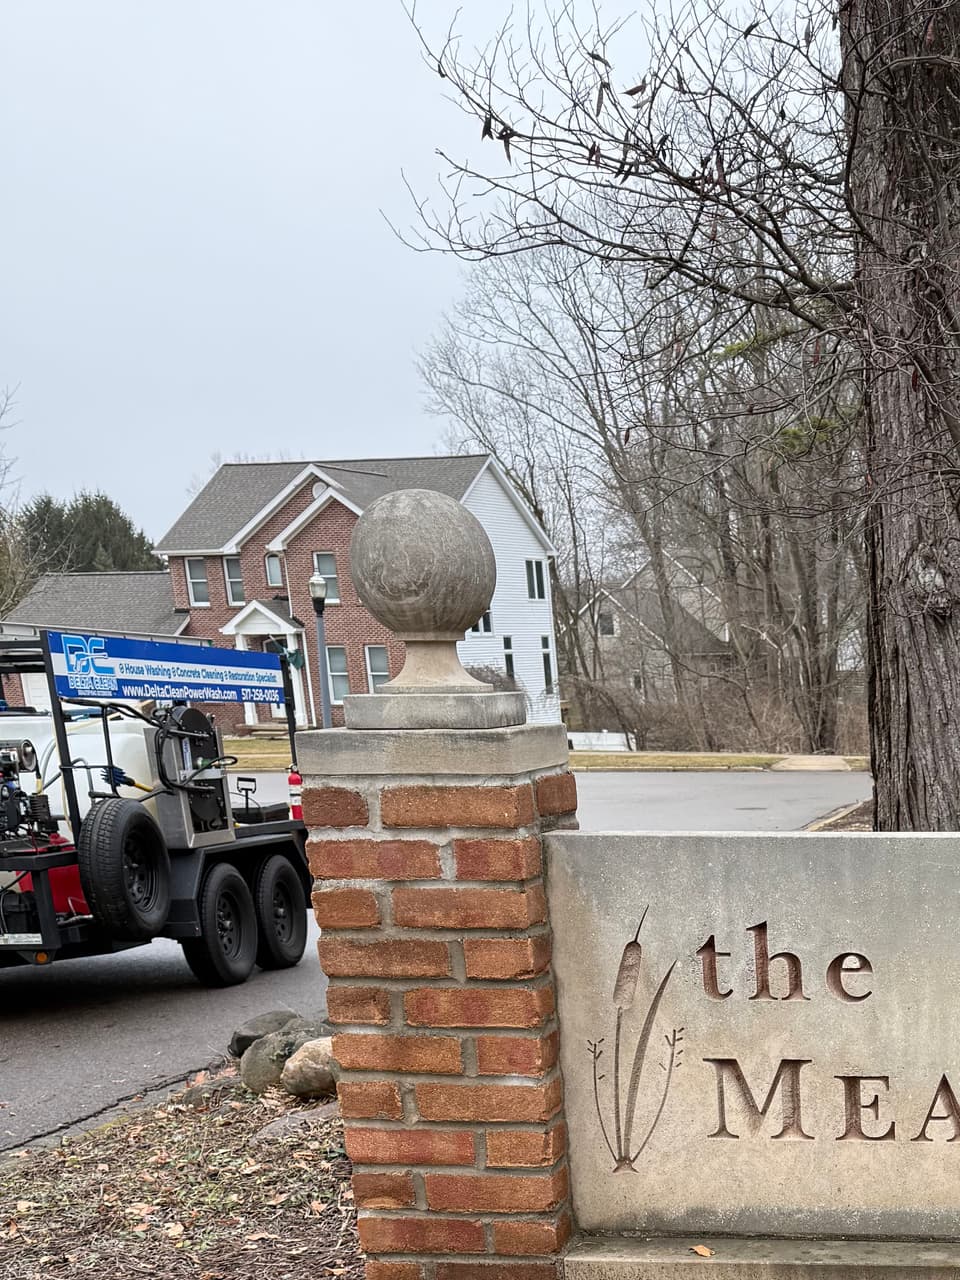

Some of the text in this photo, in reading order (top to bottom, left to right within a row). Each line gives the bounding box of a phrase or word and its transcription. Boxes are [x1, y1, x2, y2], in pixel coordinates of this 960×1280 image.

[125, 663, 144, 674] House
[146, 664, 171, 678] Washing
[176, 667, 200, 678] Concrete
[201, 669, 223, 681] Cleaning
[229, 671, 255, 681] Restoration
[69, 675, 118, 690] DELTA CLEAN
[122, 684, 237, 700] www.DeltaCleanPowerWash.com
[241, 688, 279, 701] 517-258-0036
[697, 921, 874, 1002] the
